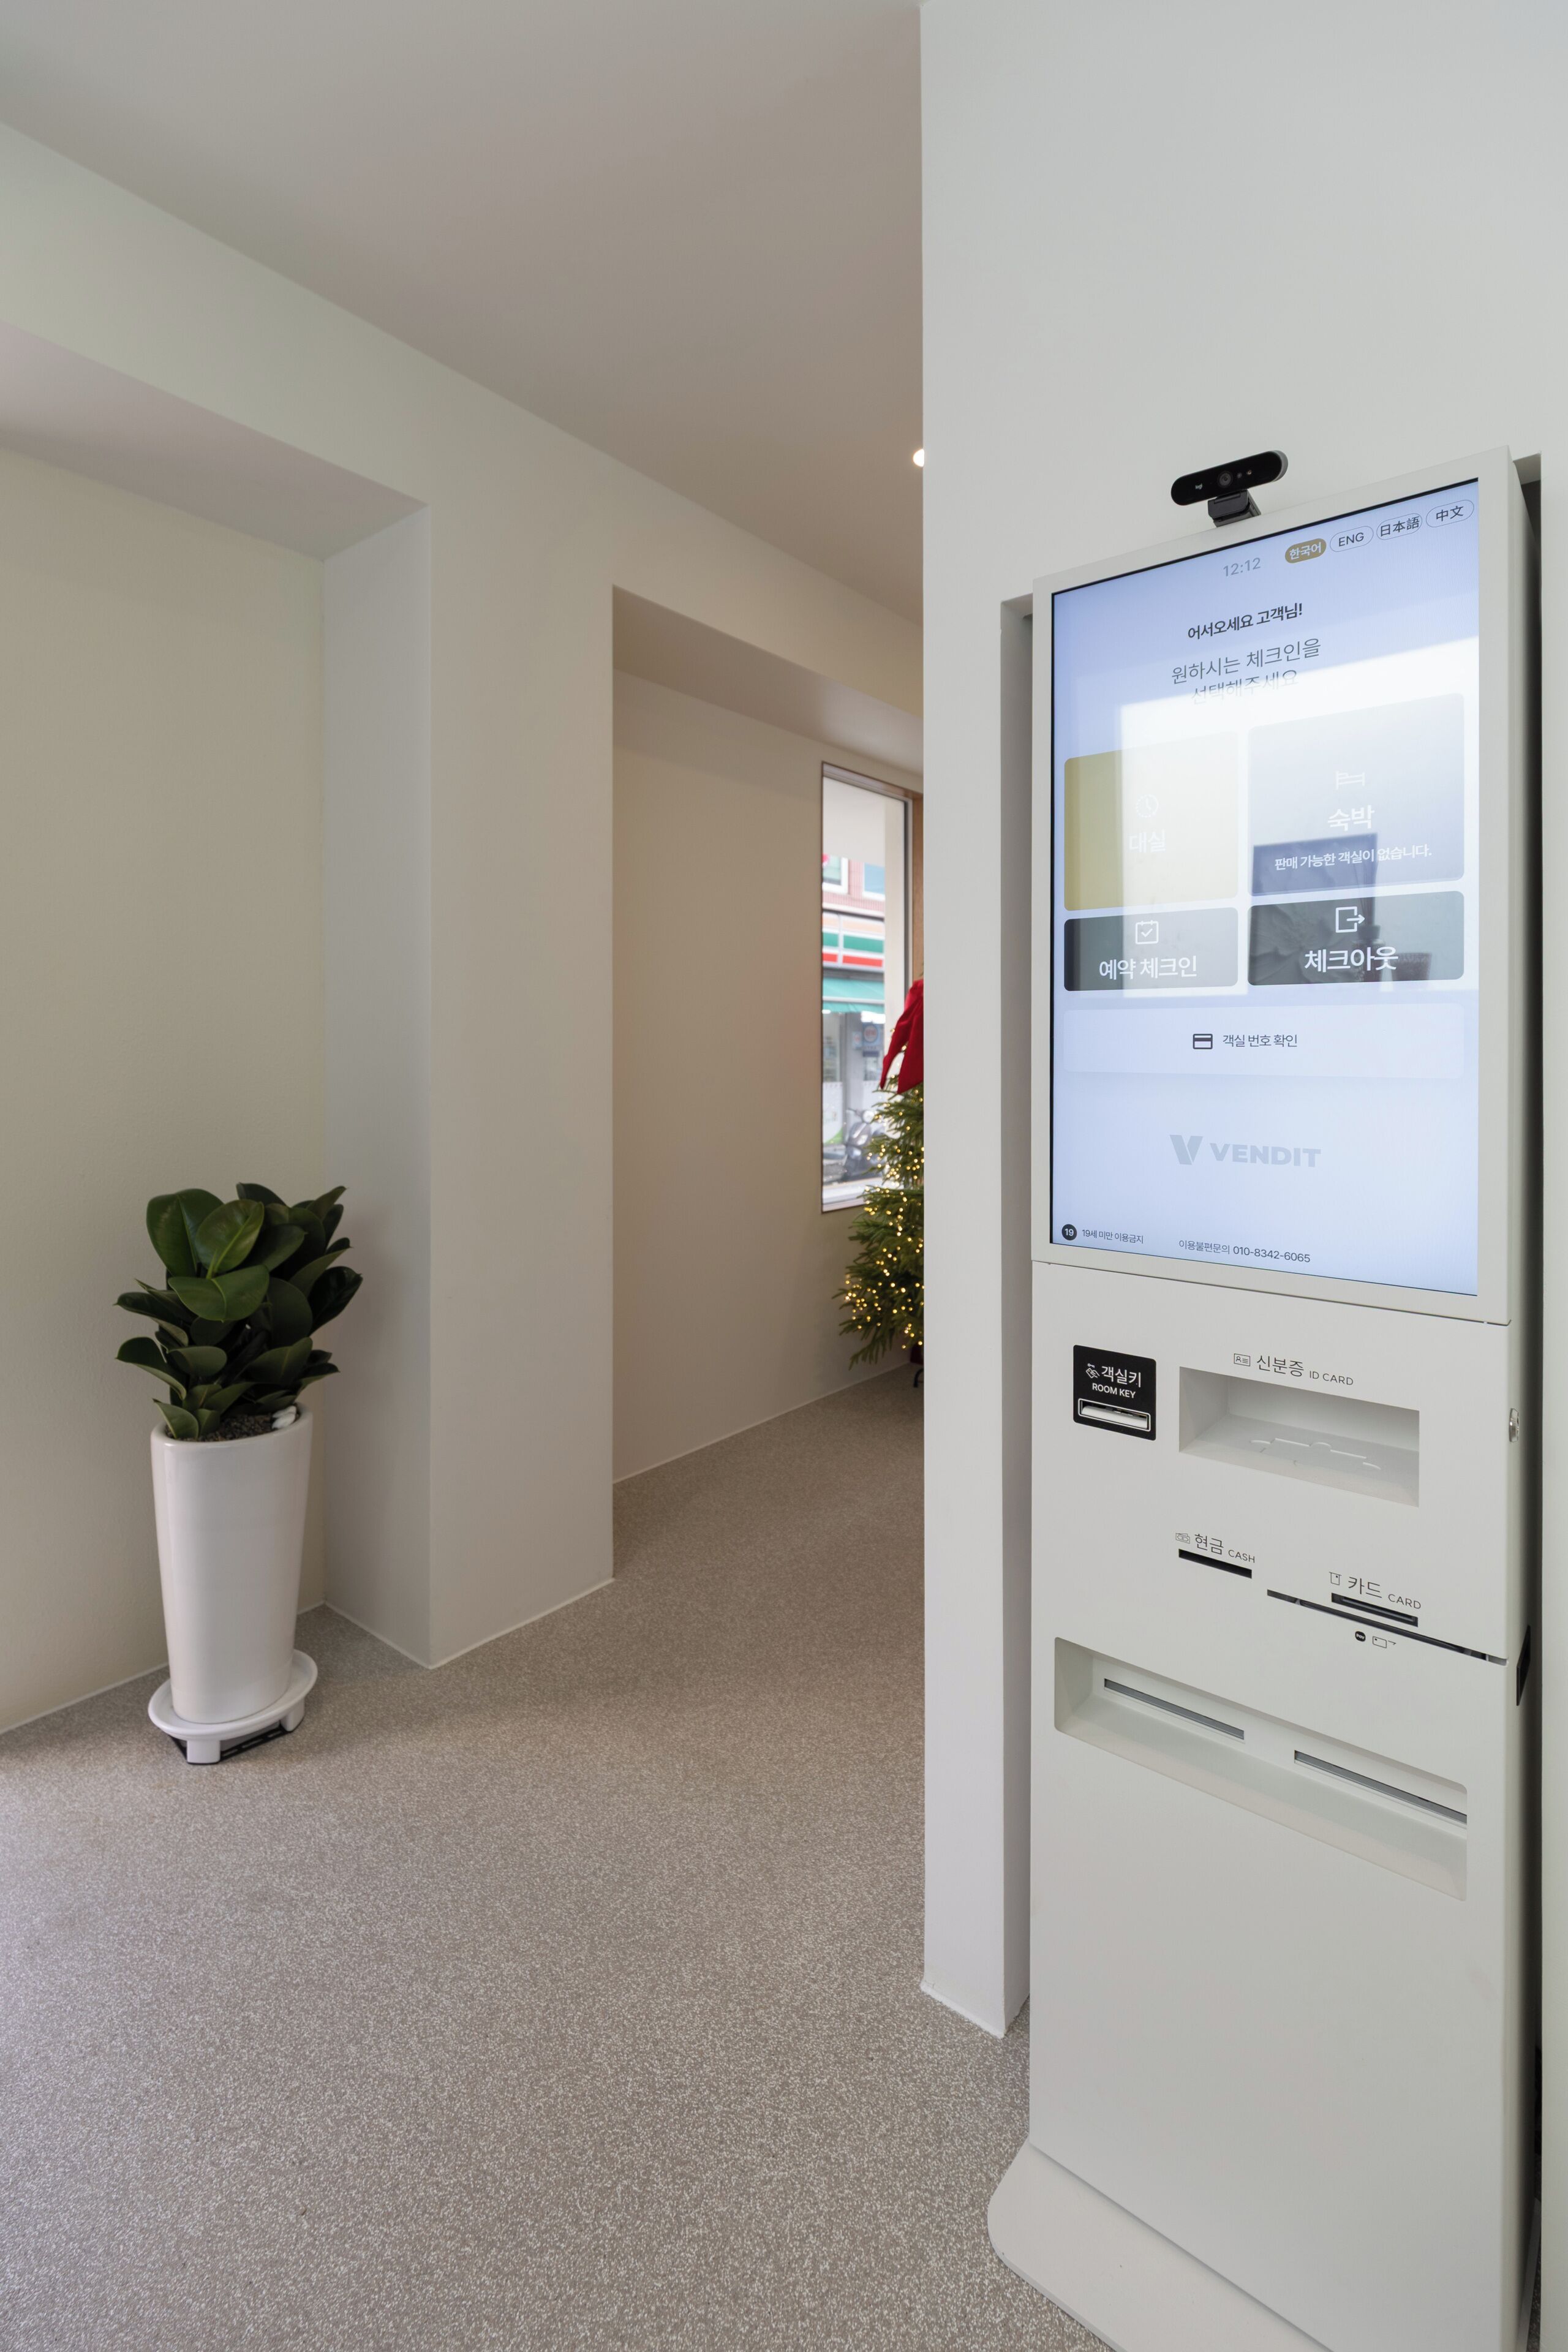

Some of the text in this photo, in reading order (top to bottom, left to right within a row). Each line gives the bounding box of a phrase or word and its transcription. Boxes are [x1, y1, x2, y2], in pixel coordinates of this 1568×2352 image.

[1436, 505, 1464, 522] 中文
[1380, 516, 1420, 537] 日本語
[1289, 542, 1322, 560] 한국어
[1338, 532, 1365, 547] ENG
[1223, 557, 1261, 576] 12:12
[1188, 603, 1303, 639] 어서오세요 고객님!
[1171, 638, 1321, 684] 원하시는 체크인을
[1327, 805, 1375, 831] 숙박
[1275, 843, 1432, 870] 판매 가능한 객실이 없습니다.
[1099, 955, 1197, 980] 예약 체크인
[1305, 946, 1398, 973] 체크아웃
[1223, 1035, 1297, 1047] 객실 번호 확인
[1210, 1143, 1321, 1167] VENDIT
[1065, 1228, 1074, 1237] 19
[1082, 1229, 1144, 1244] 19세 미만 이용금지
[1178, 1240, 1311, 1263] 이용불편문의 010-8342-6065
[1101, 1365, 1142, 1388] 객실키
[1256, 1355, 1354, 1386] 신분증 ID CARD
[1092, 1382, 1136, 1400] ROOM KEY
[1194, 1533, 1256, 1564] 현금 CASH
[1348, 1577, 1422, 1610] 카드 CARD
